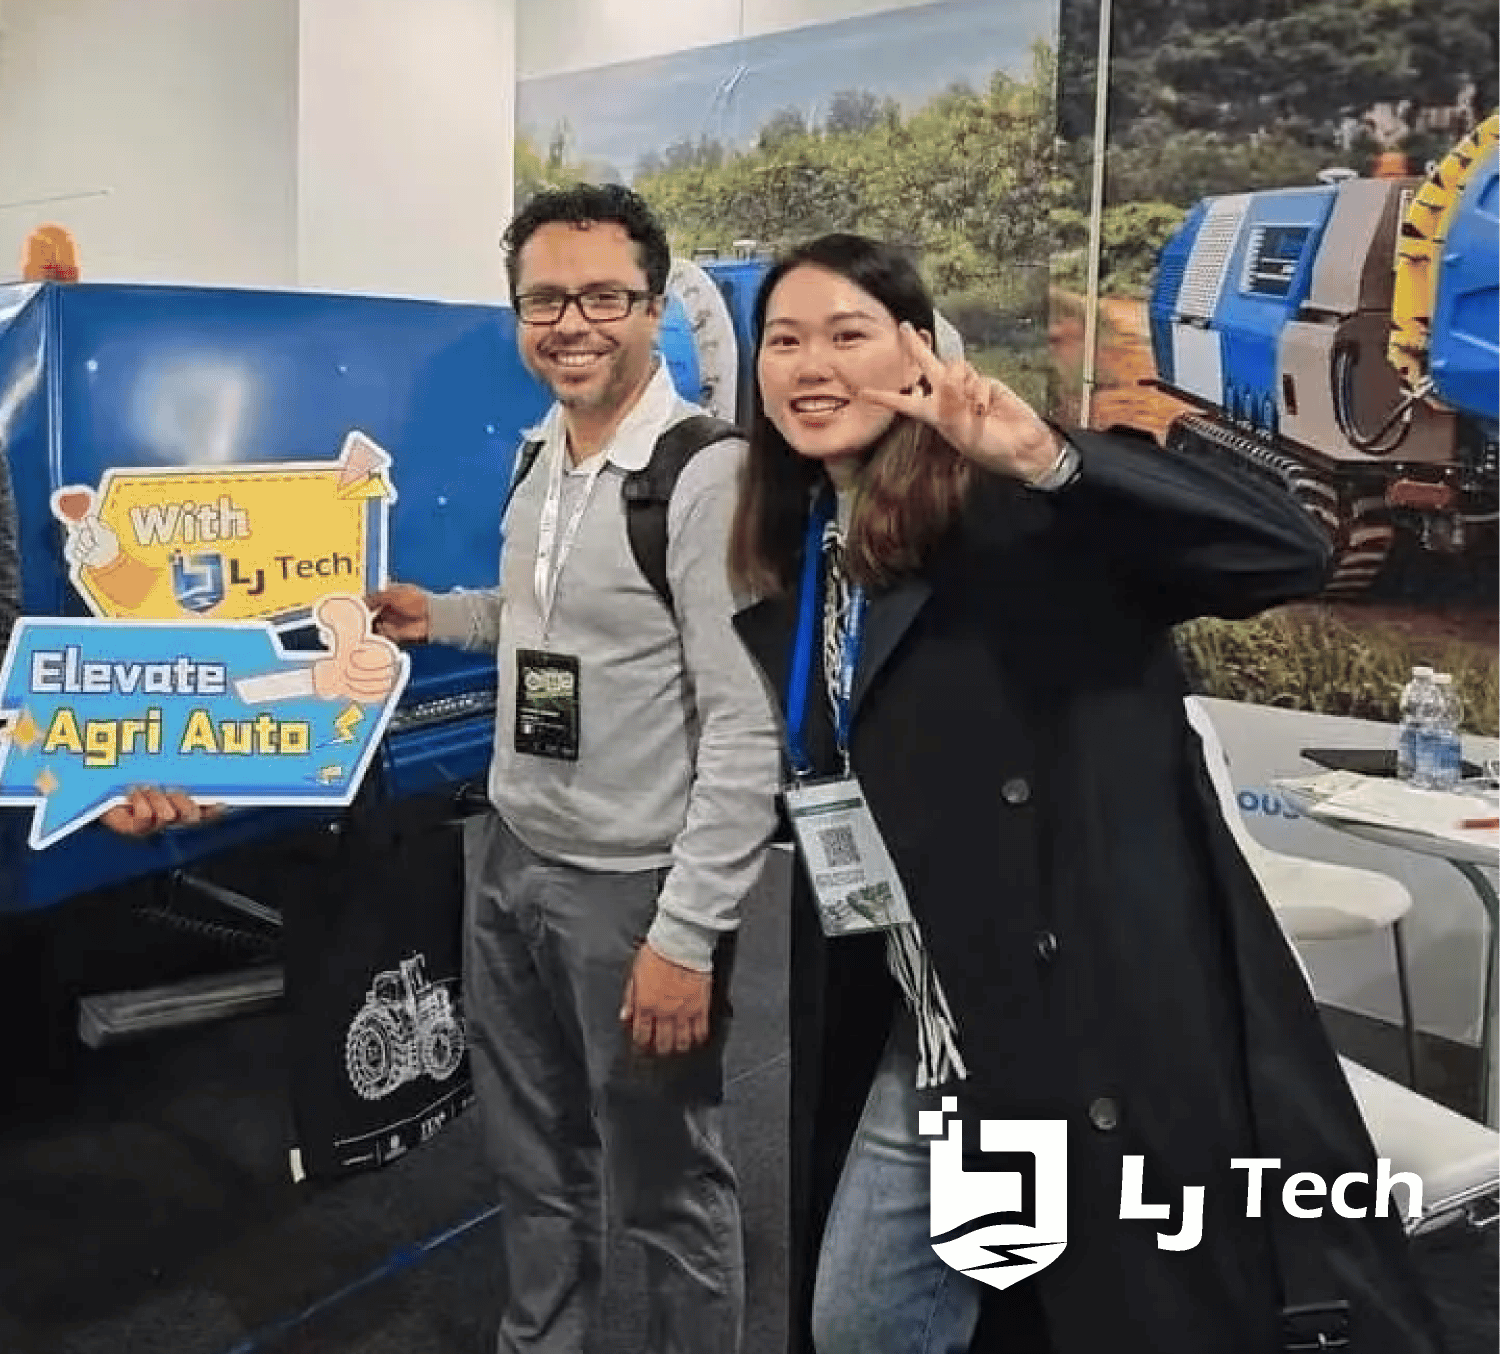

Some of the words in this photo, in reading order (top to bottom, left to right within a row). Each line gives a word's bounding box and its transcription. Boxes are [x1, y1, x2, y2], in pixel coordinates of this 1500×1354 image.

[129, 494, 253, 546] With
[274, 552, 353, 580] Tech
[30, 644, 227, 695] Elevate
[42, 705, 163, 769] Agri
[177, 706, 311, 756] Auto
